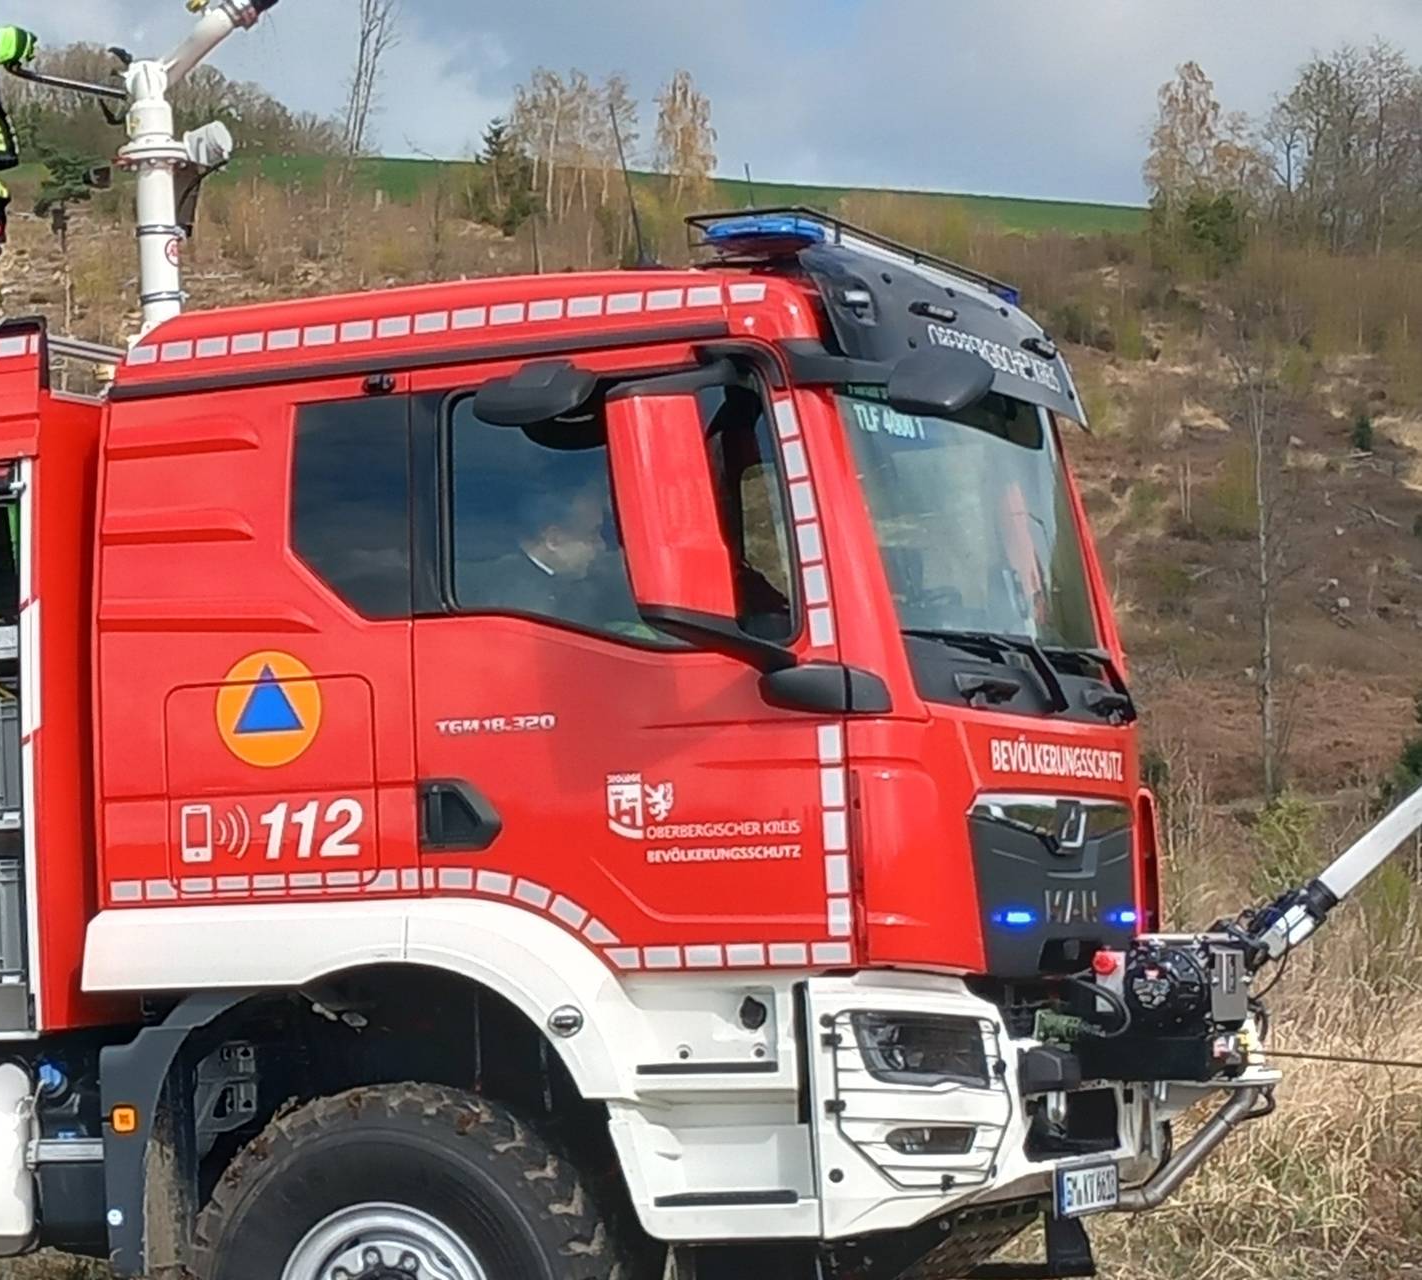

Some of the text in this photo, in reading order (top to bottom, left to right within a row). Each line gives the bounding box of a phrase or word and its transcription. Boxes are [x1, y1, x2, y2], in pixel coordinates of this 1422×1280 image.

[853, 404, 879, 432] TLF
[436, 714, 555, 735] TGM 18.320
[991, 737, 1123, 780] BEVÖLKERUNGSSCHUTZ
[260, 798, 363, 860] 112
[646, 820, 801, 839] OBERBERGISCHER KREIS
[646, 845, 802, 863] BEVÖLKERUNGSSCHUTZ
